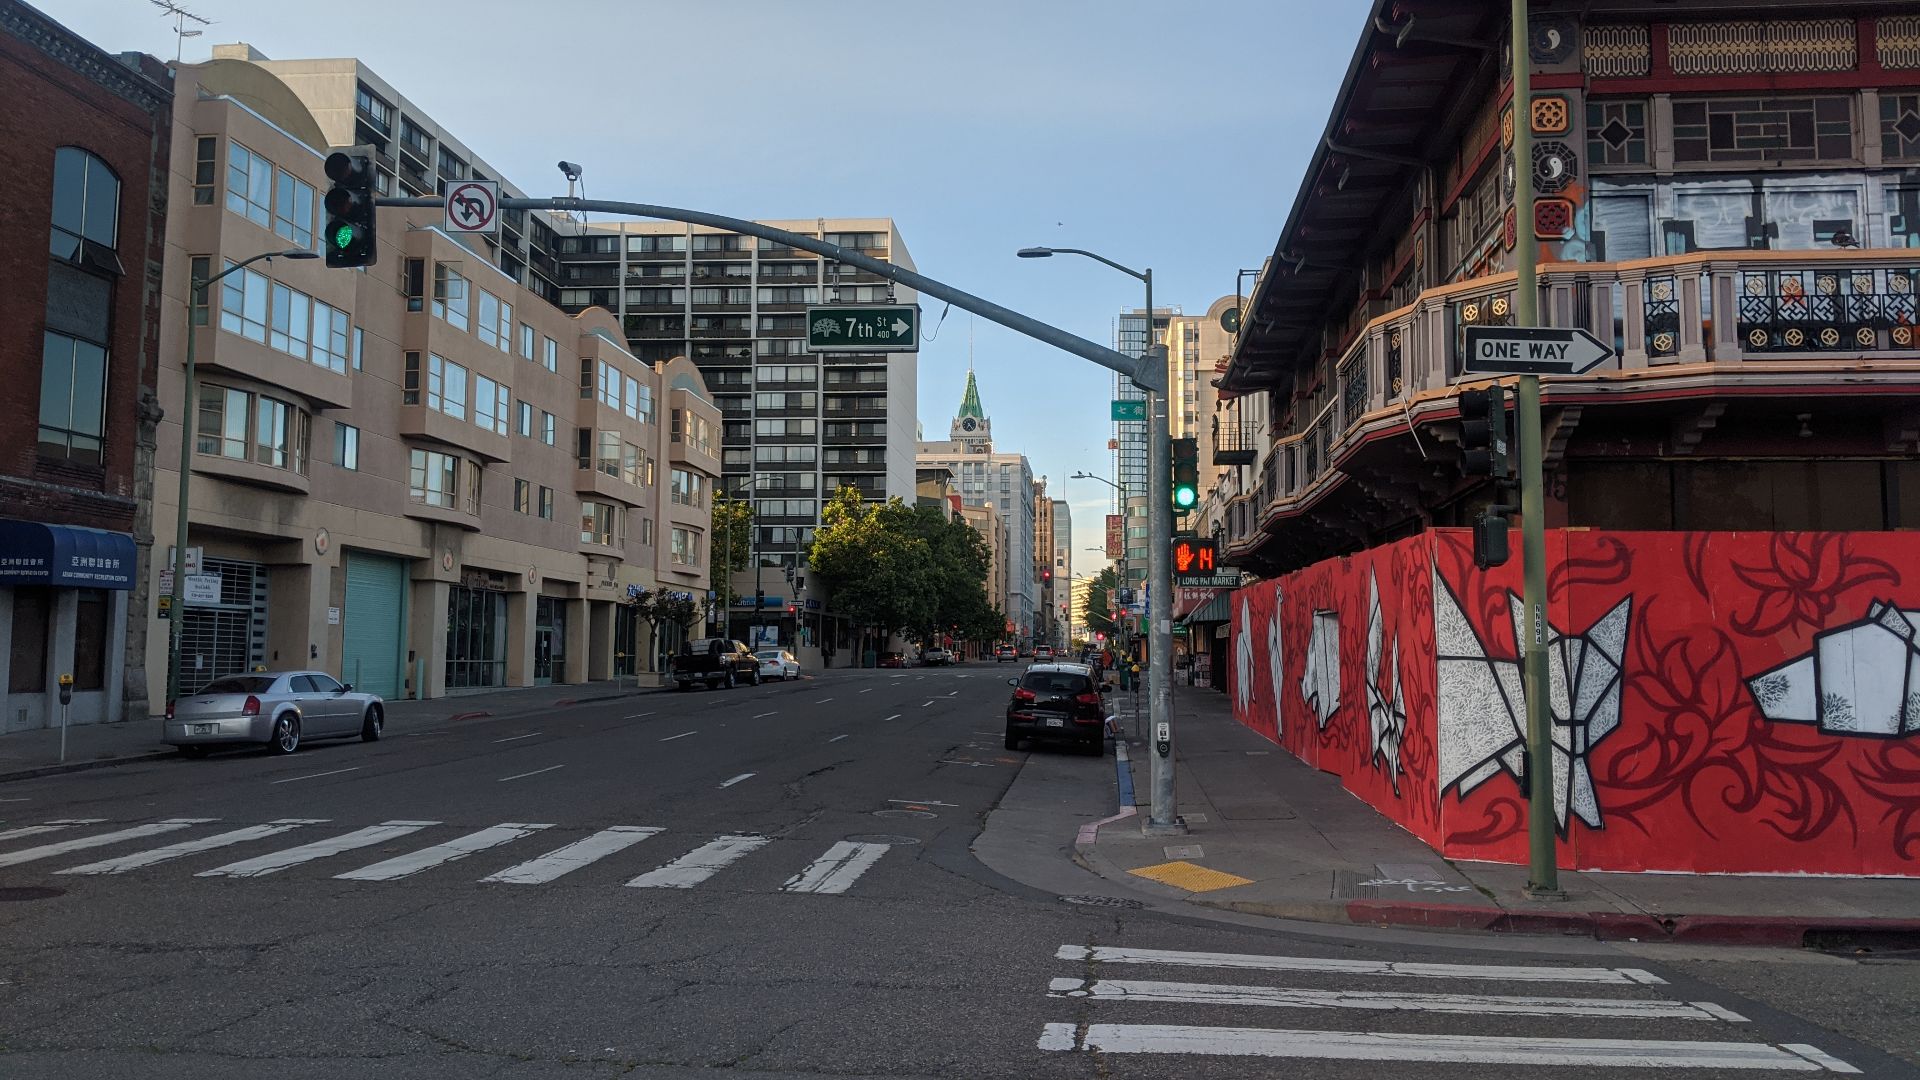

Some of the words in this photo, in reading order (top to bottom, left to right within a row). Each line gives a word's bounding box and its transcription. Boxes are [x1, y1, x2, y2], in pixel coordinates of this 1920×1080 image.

[846, 318, 873, 338] 7th
[877, 317, 887, 327] St
[877, 331, 890, 339] 400
[1481, 342, 1521, 358] ONE
[1528, 343, 1570, 360] WAY
[1199, 547, 1213, 570] 14
[1182, 577, 1199, 585] LONG
[1211, 577, 1236, 586] MARKET
